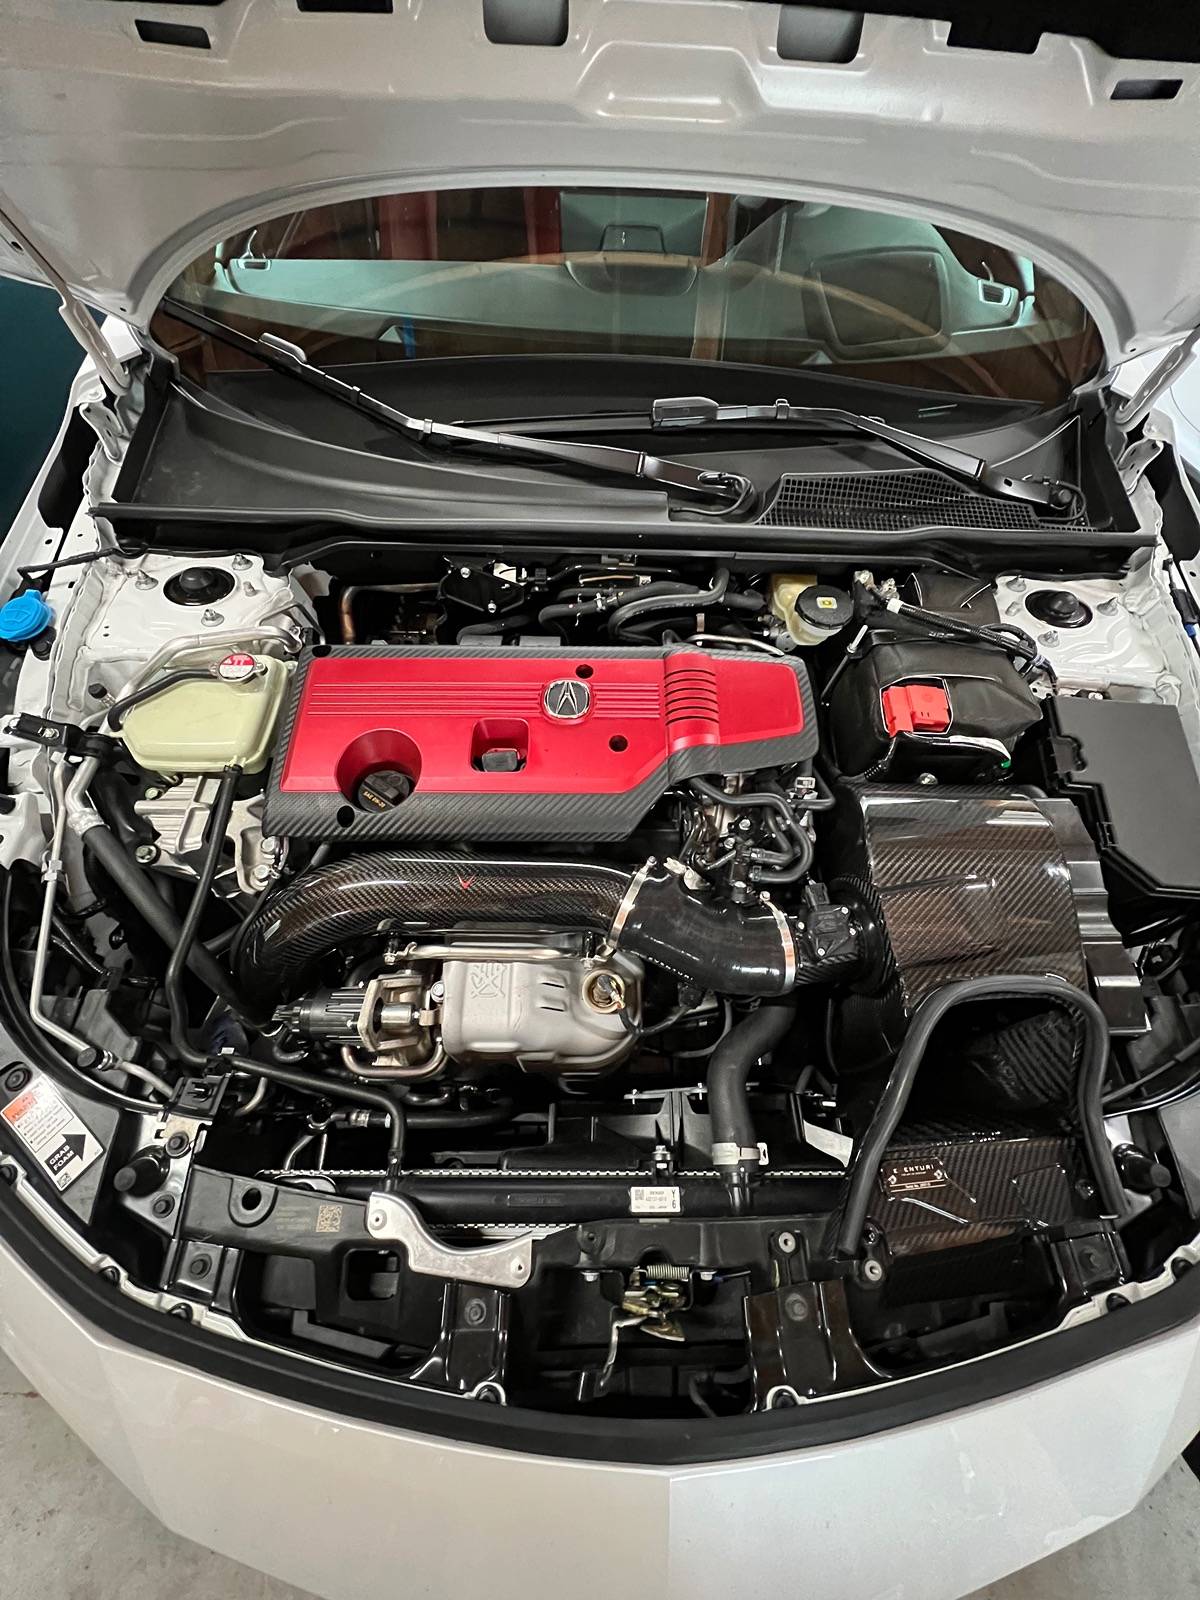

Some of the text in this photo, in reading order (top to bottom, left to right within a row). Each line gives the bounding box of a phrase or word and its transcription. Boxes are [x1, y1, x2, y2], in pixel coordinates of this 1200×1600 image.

[49, 1144, 70, 1165] GRAB
[53, 1149, 75, 1171] FOAM
[892, 1164, 934, 1174] EENTURI
[671, 1199, 677, 1209] 6
